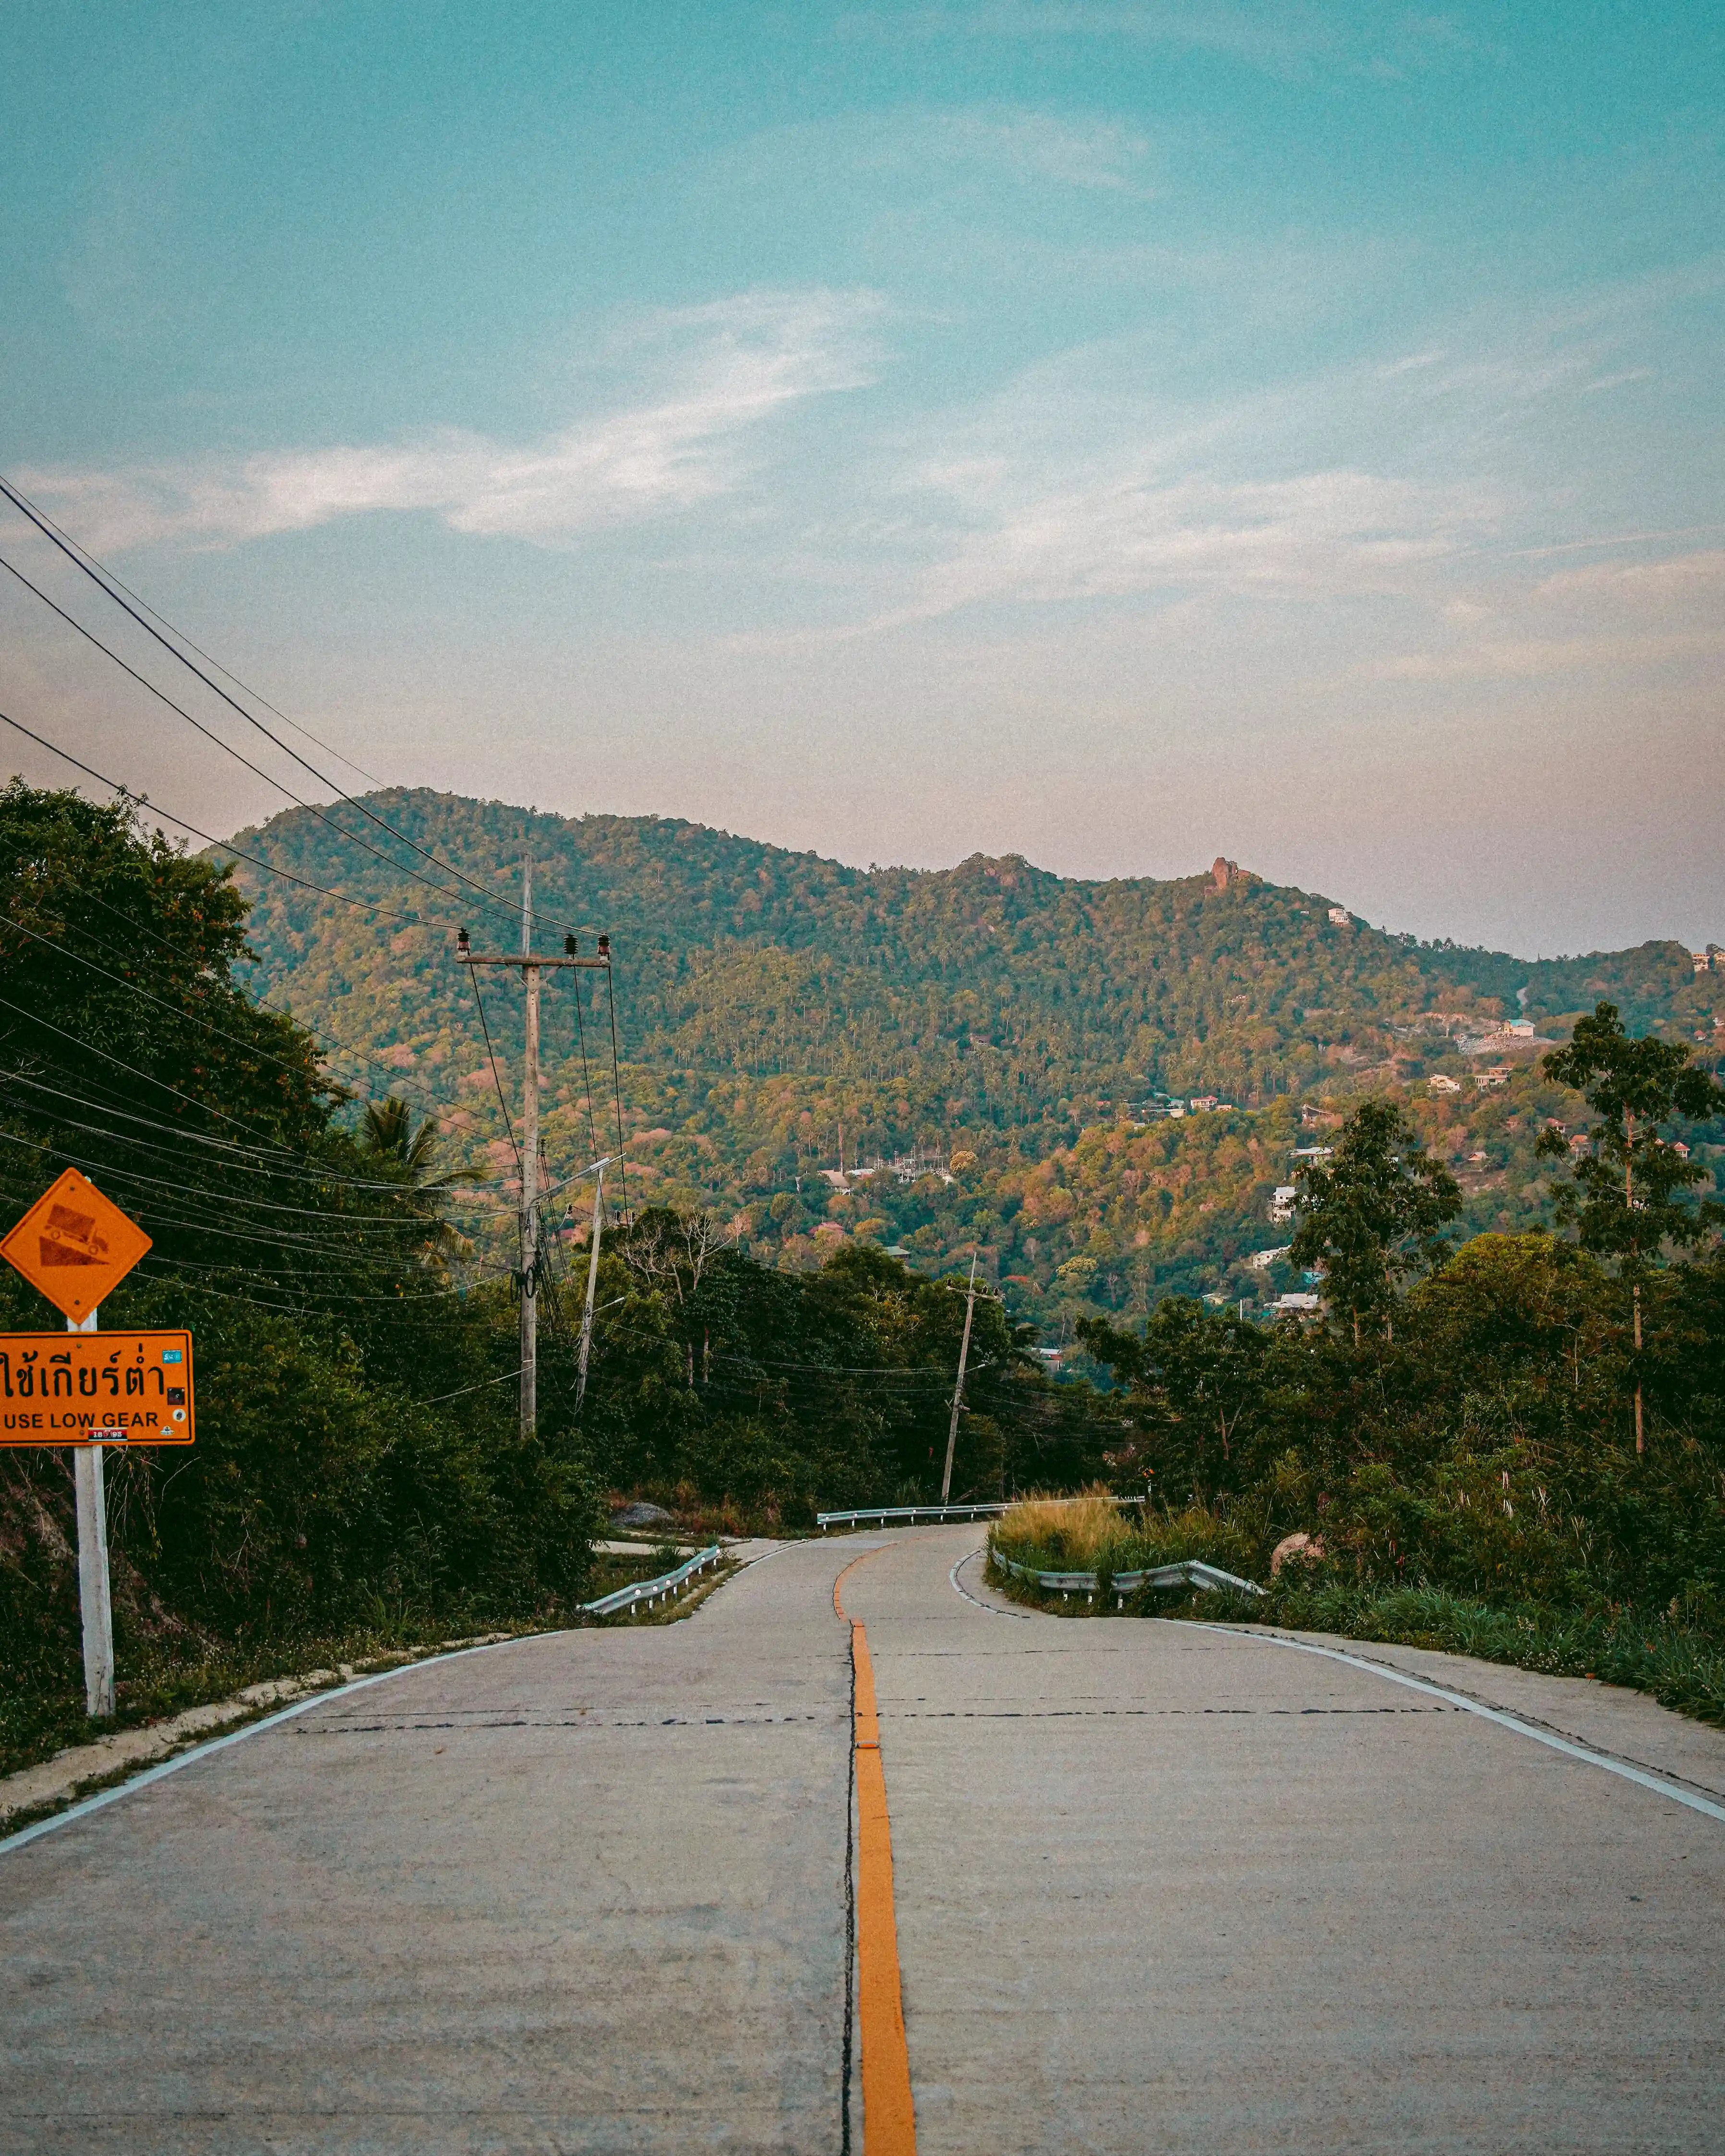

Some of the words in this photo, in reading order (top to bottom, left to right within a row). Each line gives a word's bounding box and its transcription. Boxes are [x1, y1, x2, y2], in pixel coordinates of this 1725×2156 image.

[4, 1413, 43, 1429] USE
[50, 1412, 95, 1428] LOW
[103, 1412, 158, 1427] GEAR
